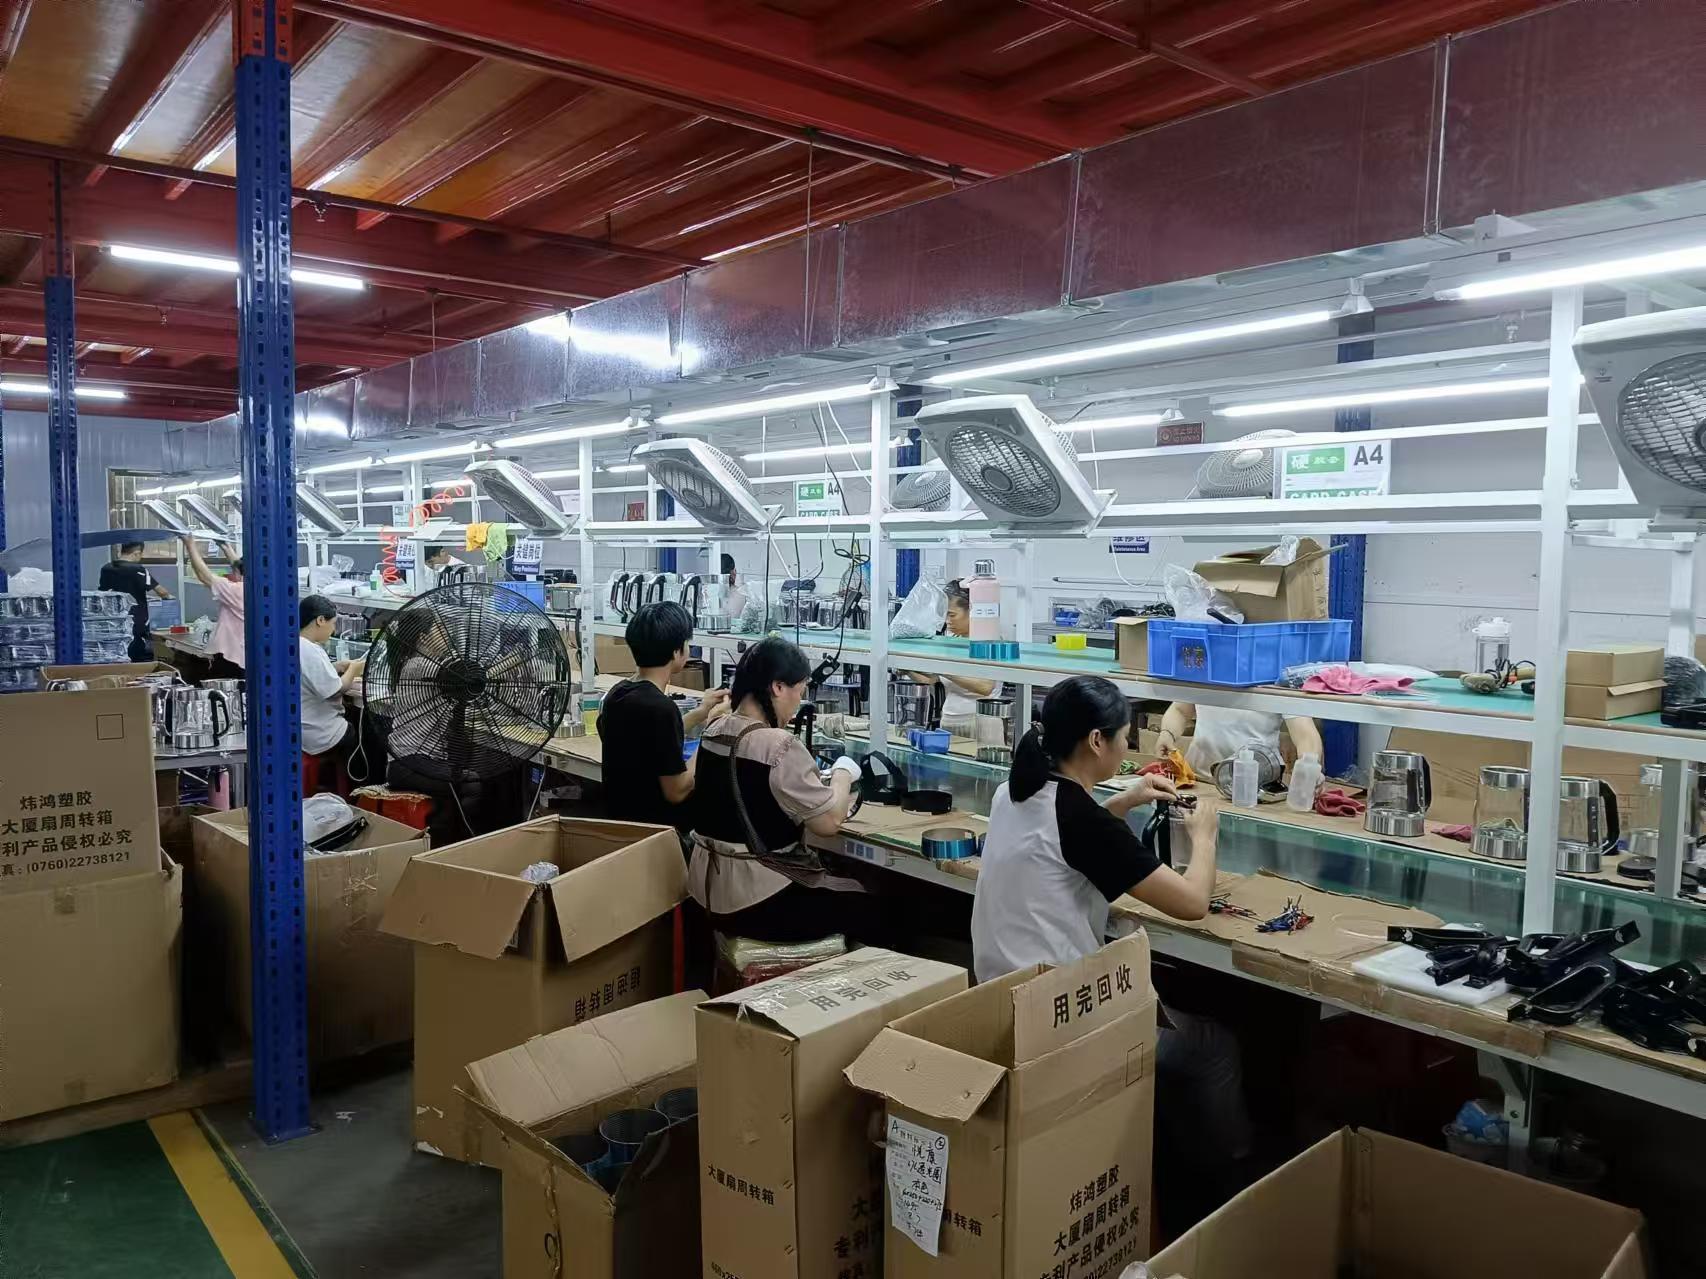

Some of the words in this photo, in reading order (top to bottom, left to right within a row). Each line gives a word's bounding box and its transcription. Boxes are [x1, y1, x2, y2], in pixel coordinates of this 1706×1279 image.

[1353, 444, 1384, 466] A4
[20, 790, 92, 811] 炜鸿塑胶
[1, 809, 113, 835] 大厦扇周转箱
[2, 829, 132, 857] 利产品侵权必究
[809, 970, 917, 1012] 用完回收
[1053, 963, 1132, 1029] 用完回收
[707, 1163, 775, 1206] 大厦扇周转箱
[1069, 1164, 1119, 1215] 炜鸿塑胶
[1053, 1184, 1130, 1257] 大厦扇周转箱
